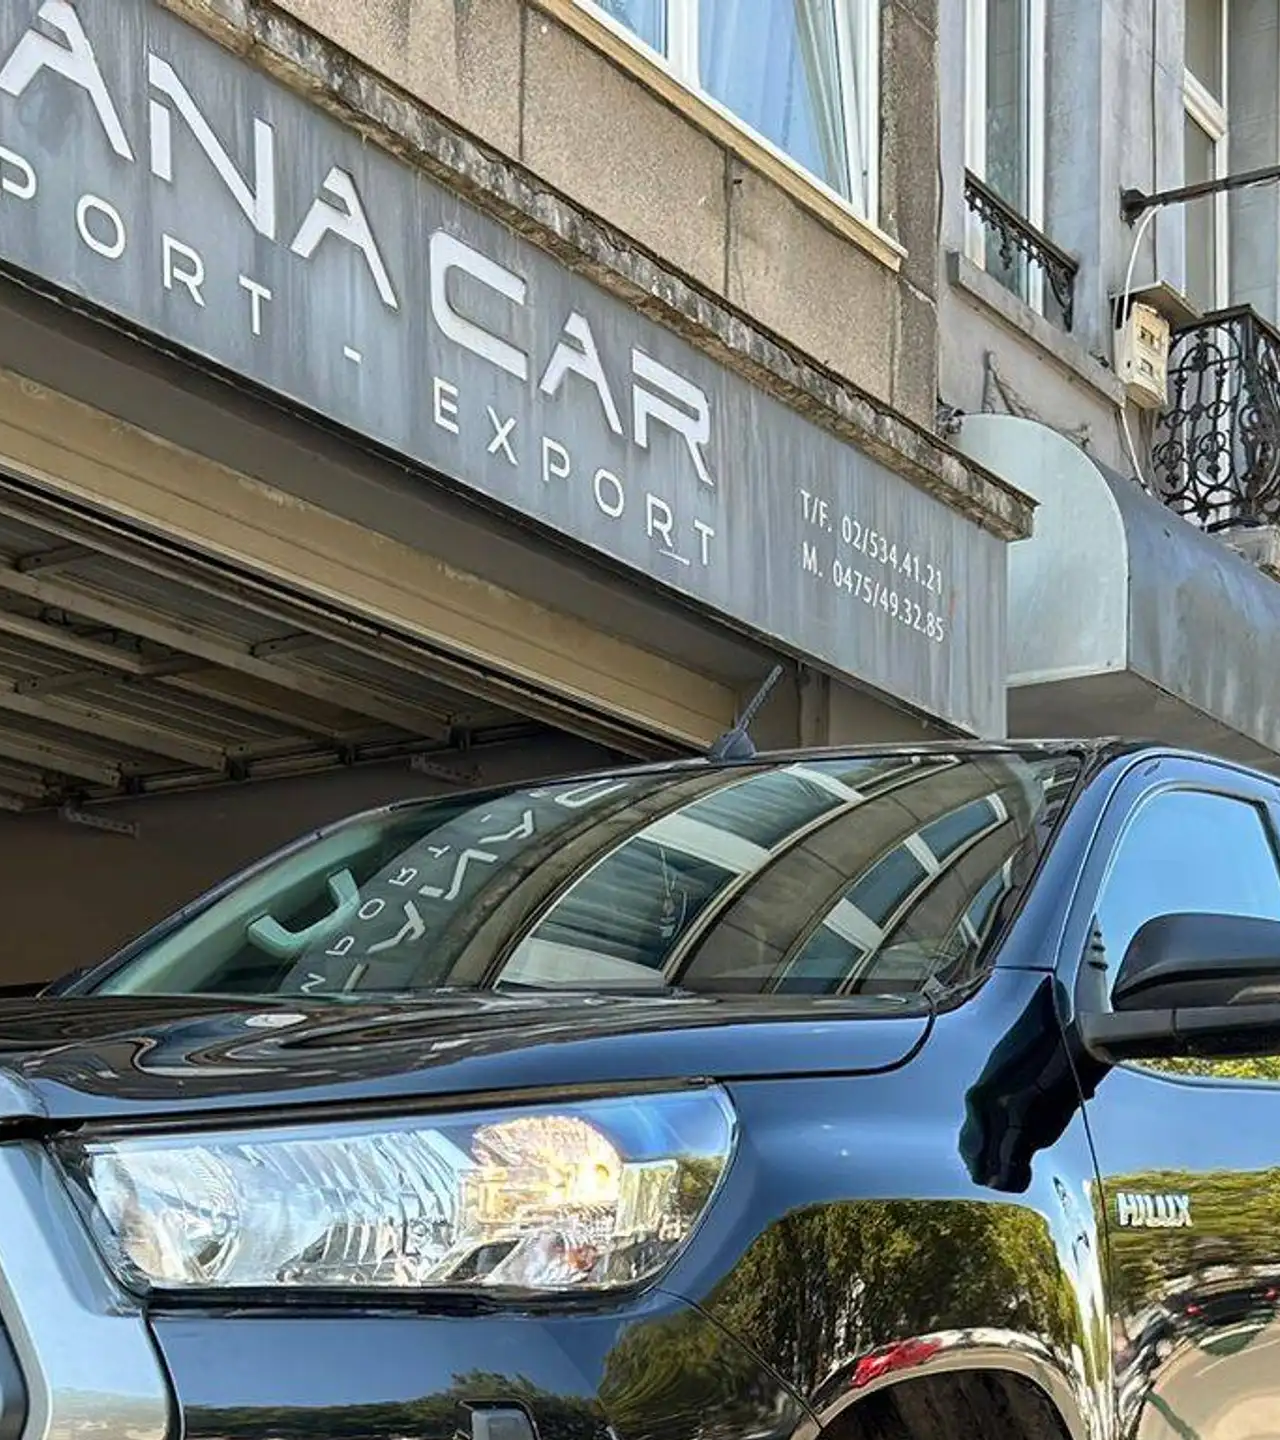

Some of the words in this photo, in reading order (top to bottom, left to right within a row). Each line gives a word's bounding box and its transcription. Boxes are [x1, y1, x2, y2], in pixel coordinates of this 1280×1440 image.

[433, 376, 716, 566] EXPORT
[800, 488, 833, 533] T/F.
[842, 515, 942, 594] 02/534.41.21
[802, 541, 823, 578] M.
[832, 560, 944, 642] 0475/49.32.85
[1116, 1192, 1195, 1228] HILUX
